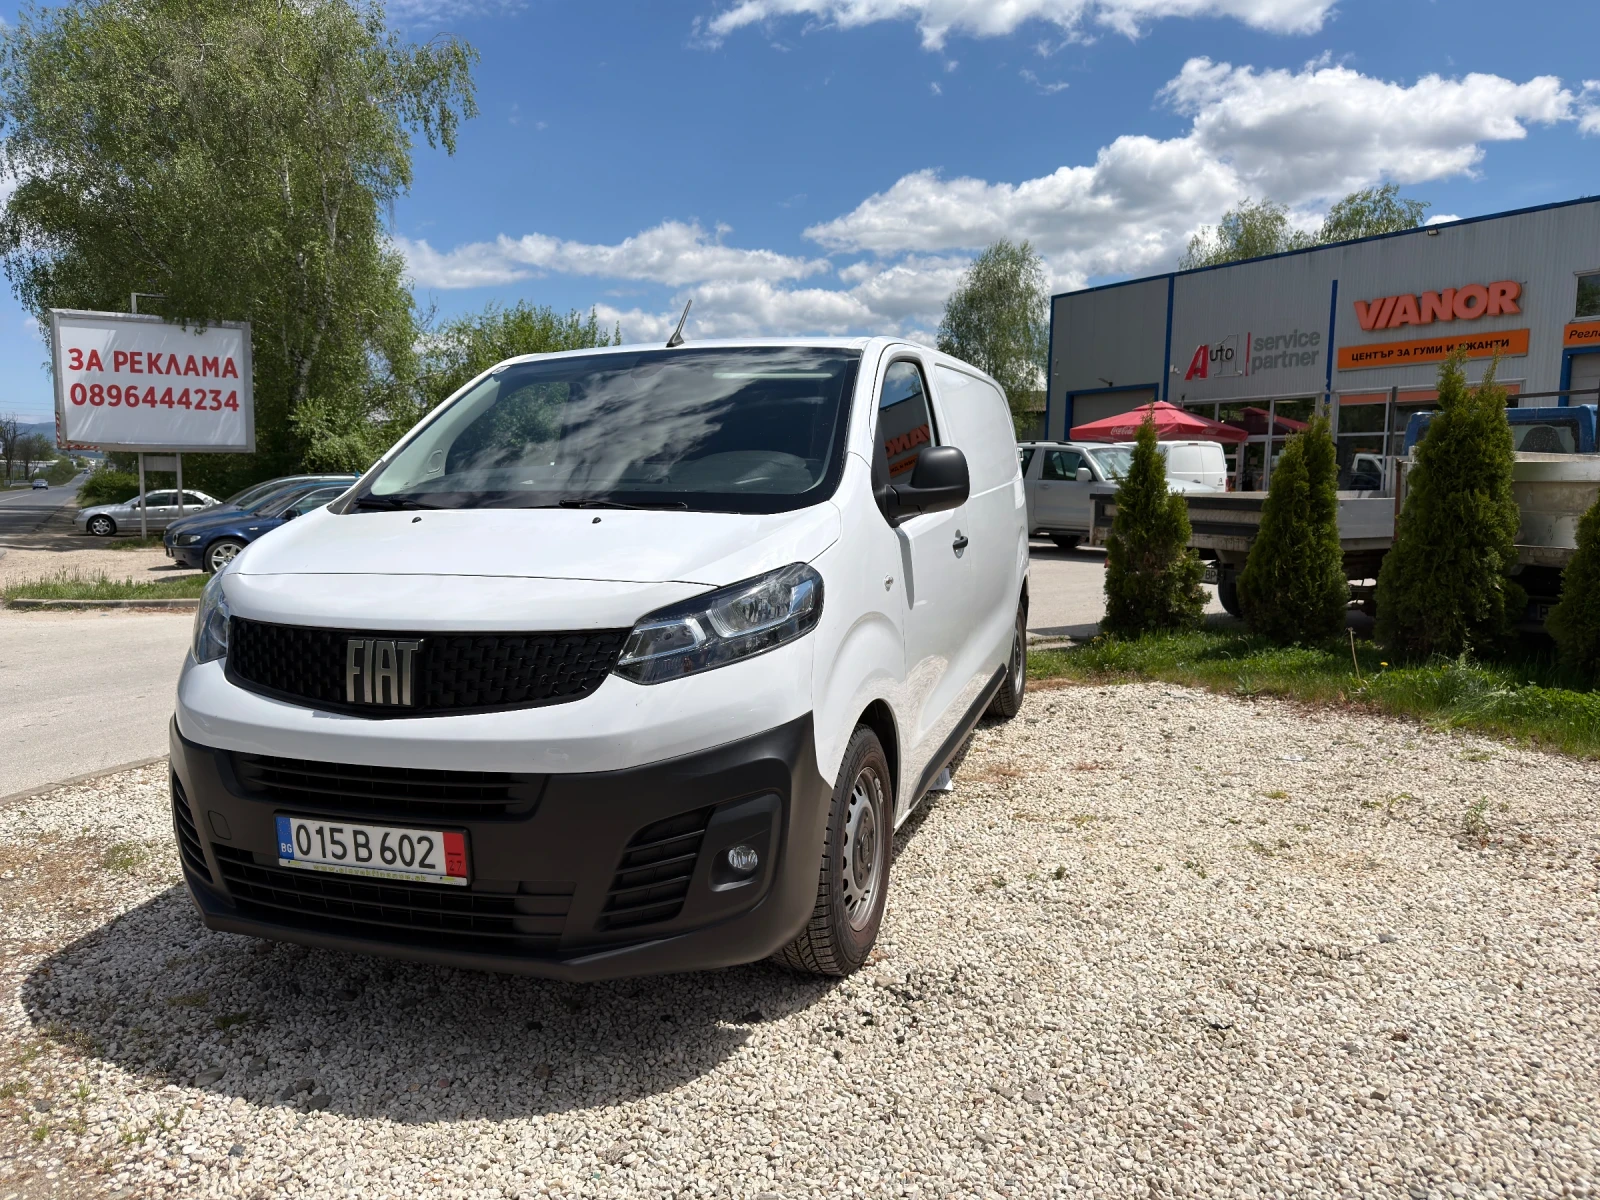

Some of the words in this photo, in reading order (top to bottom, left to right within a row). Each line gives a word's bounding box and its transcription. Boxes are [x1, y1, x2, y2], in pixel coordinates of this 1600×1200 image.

[1354, 280, 1521, 330] VIANOR
[1253, 329, 1320, 352] service
[1569, 329, 1600, 340] Регл
[68, 348, 104, 372] ЗА
[113, 350, 239, 379] РЕКЛАМА
[1251, 350, 1320, 374] partner
[1351, 349, 1394, 362] ЦЕНТЪР
[1396, 347, 1410, 357] ЗА
[1413, 345, 1443, 356] ГУМИ
[1446, 343, 1454, 352] И
[70, 383, 239, 412] 0896444234
[346, 640, 419, 706] FIAT
[281, 843, 292, 853] BG
